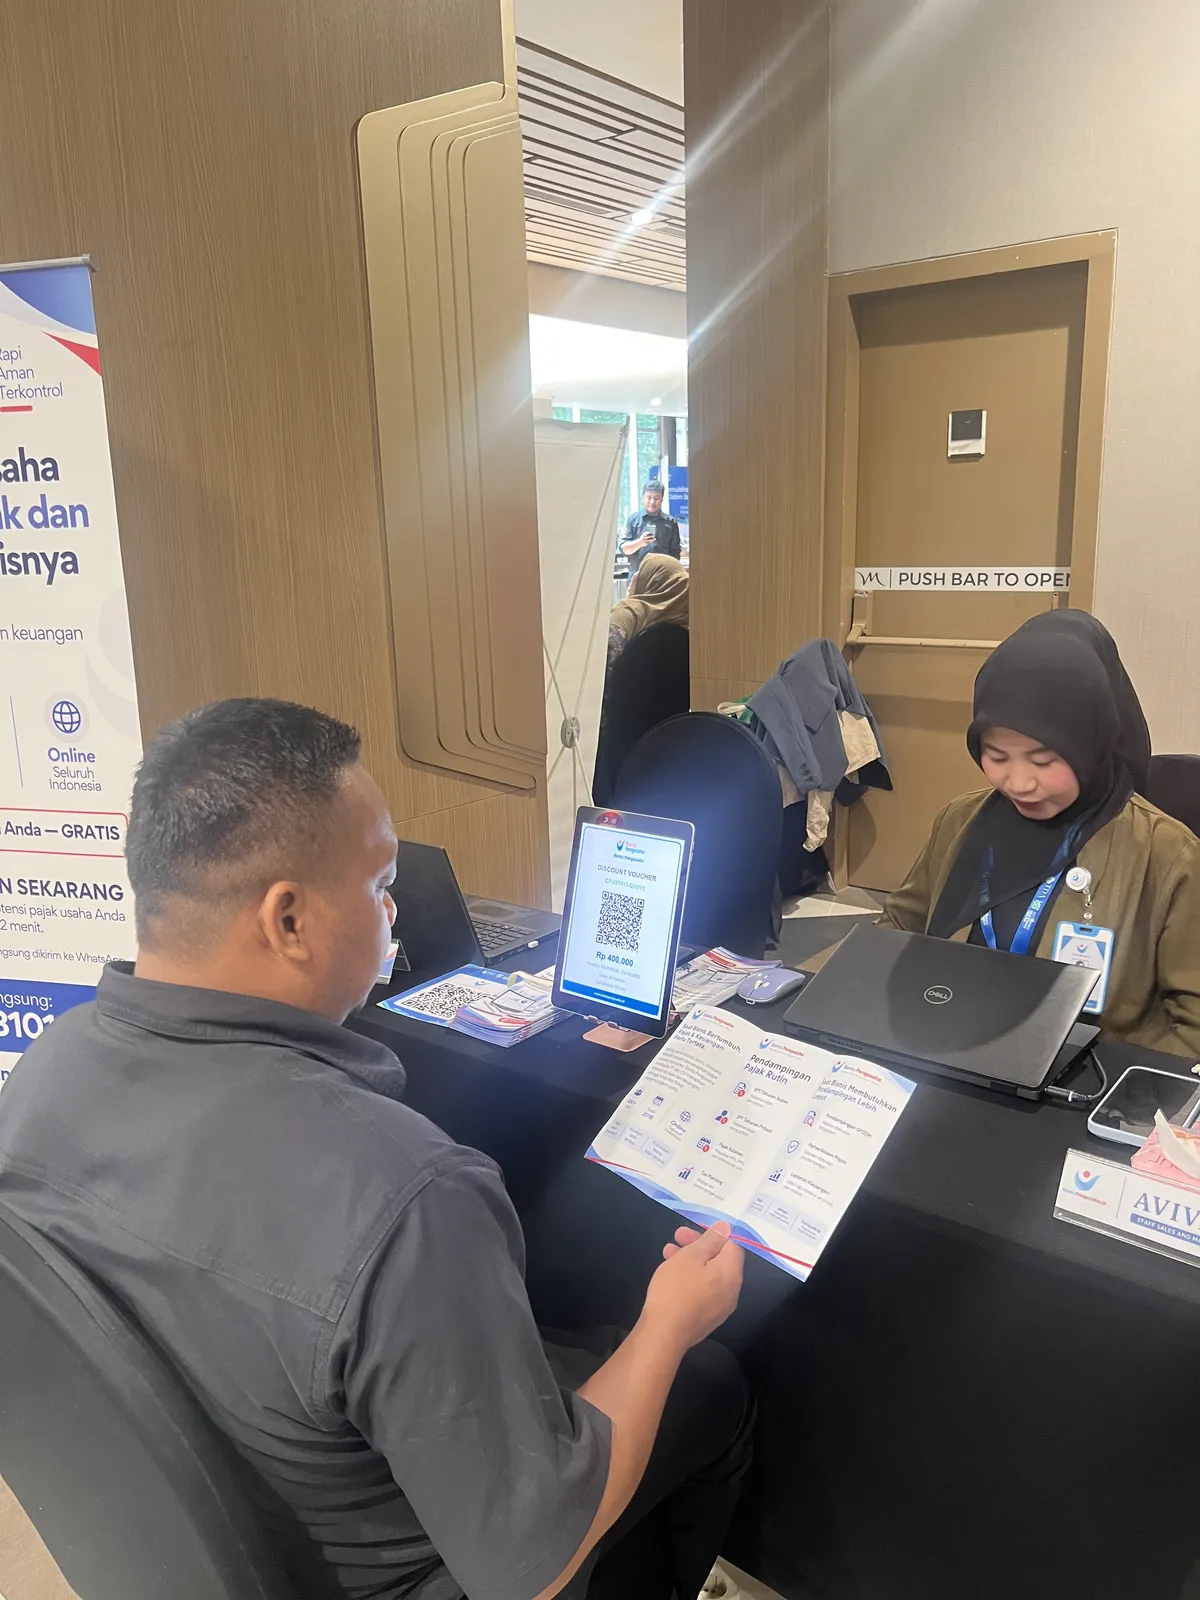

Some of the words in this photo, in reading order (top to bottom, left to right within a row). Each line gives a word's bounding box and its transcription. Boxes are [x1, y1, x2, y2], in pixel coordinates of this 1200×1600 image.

[0, 367, 35, 380] Aman
[0, 382, 64, 400] Terkontrol
[0, 447, 60, 482] aha
[0, 494, 24, 529] k
[28, 494, 90, 529] dan
[0, 541, 80, 586] isnya
[898, 572, 946, 587] PUSH
[951, 572, 989, 587] BAR
[994, 572, 1020, 587] TO
[12, 624, 84, 645] keuangan
[48, 747, 96, 764] Online
[53, 766, 95, 780] Seluruh
[49, 779, 102, 792] Indonesia
[4, 822, 42, 837] Anda
[61, 824, 120, 841] GRATIS
[597, 864, 627, 877] DISCOUNT
[628, 870, 657, 882] VOUCHER
[17, 878, 124, 902] SEKARANG
[0, 904, 27, 915] tensi
[29, 905, 58, 919] pajak
[60, 907, 92, 919] usaha
[95, 908, 126, 922] Anda
[10, 921, 44, 933] menit.
[32, 948, 61, 960] dikirim
[63, 950, 75, 962] ke
[596, 951, 606, 961] Rp
[607, 954, 634, 967] 400.000
[927, 990, 948, 1000] DELL
[706, 1030, 741, 1053] Bertumbuh,
[744, 1063, 766, 1076] Pajak
[765, 1070, 788, 1085] Rutin
[749, 1054, 811, 1082] Pendampingan
[847, 1085, 897, 1113] Membutuhkan
[857, 1097, 877, 1113] Lebih
[1133, 1191, 1200, 1230] AVIV
[1136, 1216, 1156, 1229] STAFF
[1156, 1223, 1176, 1236] SALES
[1176, 1230, 1191, 1241] AND
